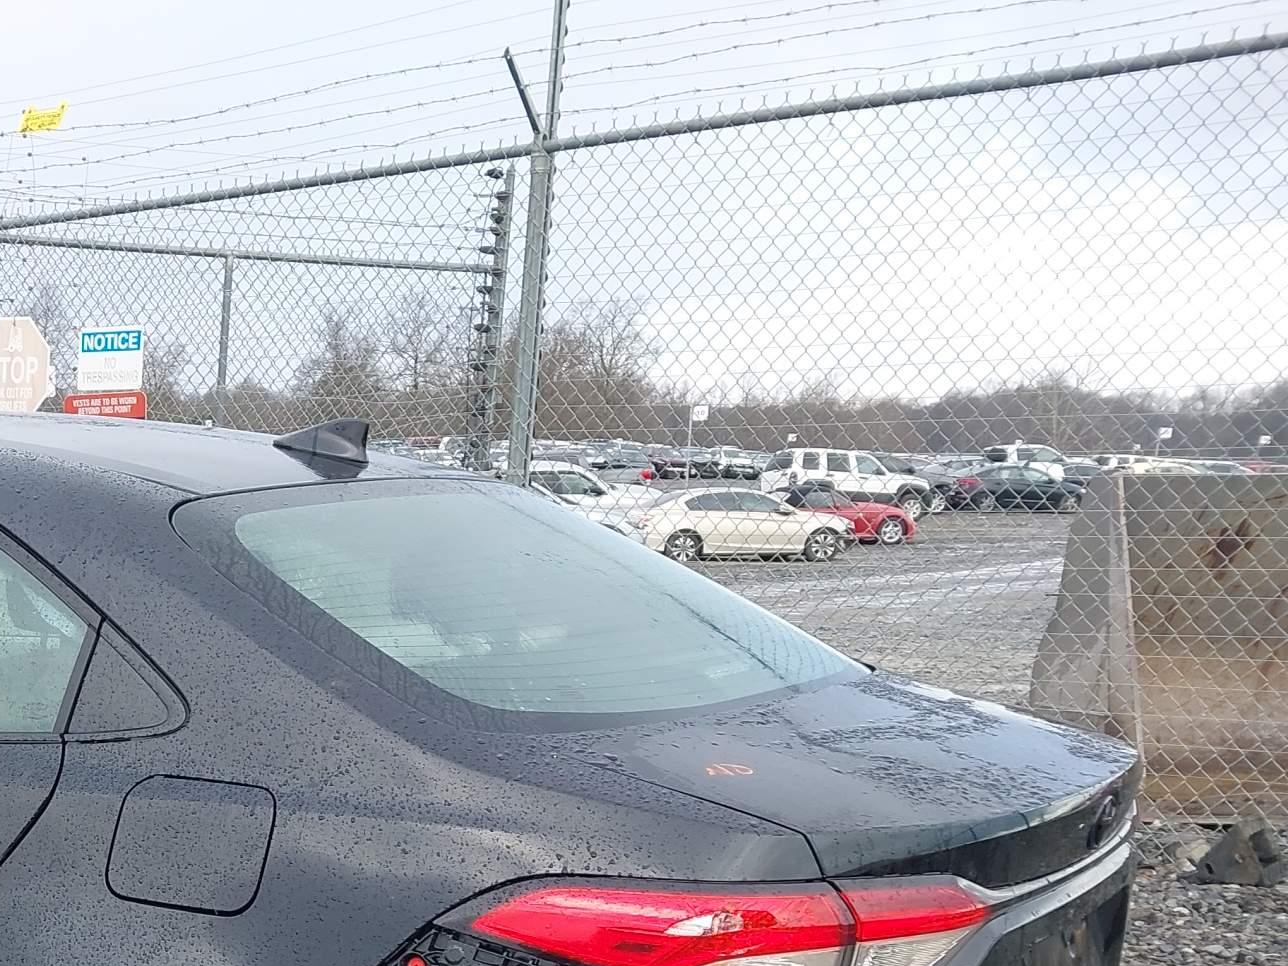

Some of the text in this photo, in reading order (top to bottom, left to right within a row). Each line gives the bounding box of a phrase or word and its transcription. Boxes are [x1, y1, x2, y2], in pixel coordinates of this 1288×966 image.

[83, 332, 139, 351] NOTICE
[104, 356, 117, 370] NO
[82, 370, 139, 385] TRESPASSING
[6, 386, 19, 399] OUT
[20, 386, 33, 399] FOR
[73, 396, 137, 408] VESTS ARE TO BE WORN
[78, 404, 131, 415] BEYOND THIS POINT
